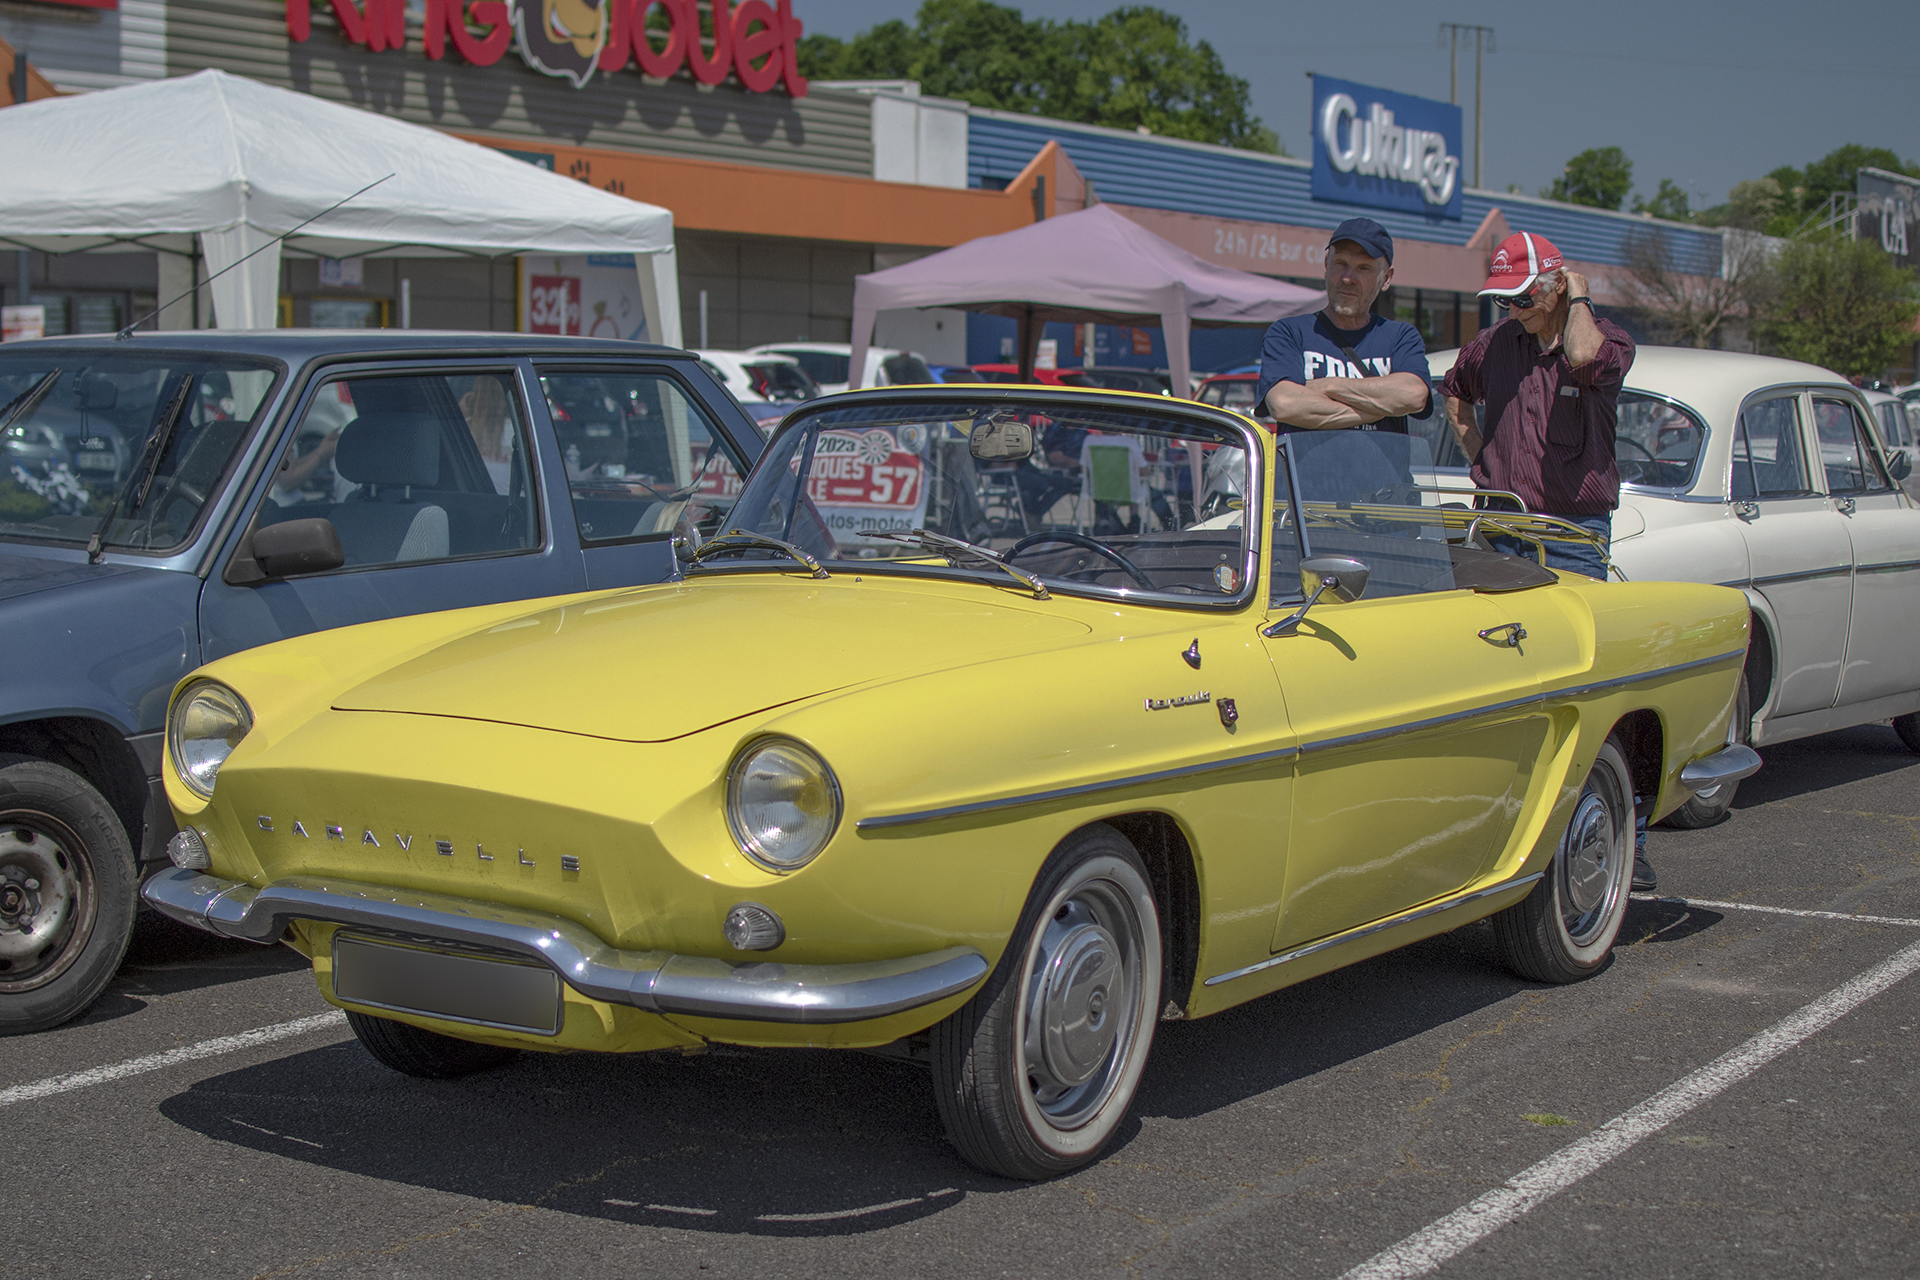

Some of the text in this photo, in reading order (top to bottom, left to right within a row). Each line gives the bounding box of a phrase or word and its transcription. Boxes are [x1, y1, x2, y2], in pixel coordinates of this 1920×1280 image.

[1324, 93, 1448, 188] Cultura
[1279, 241, 1303, 261] sur
[816, 437, 857, 454] 2023
[810, 457, 865, 480] IQUES
[806, 479, 829, 501] LE
[869, 466, 918, 503] 57
[826, 514, 912, 530] utos-motos
[257, 815, 580, 872] CARAVELLE
